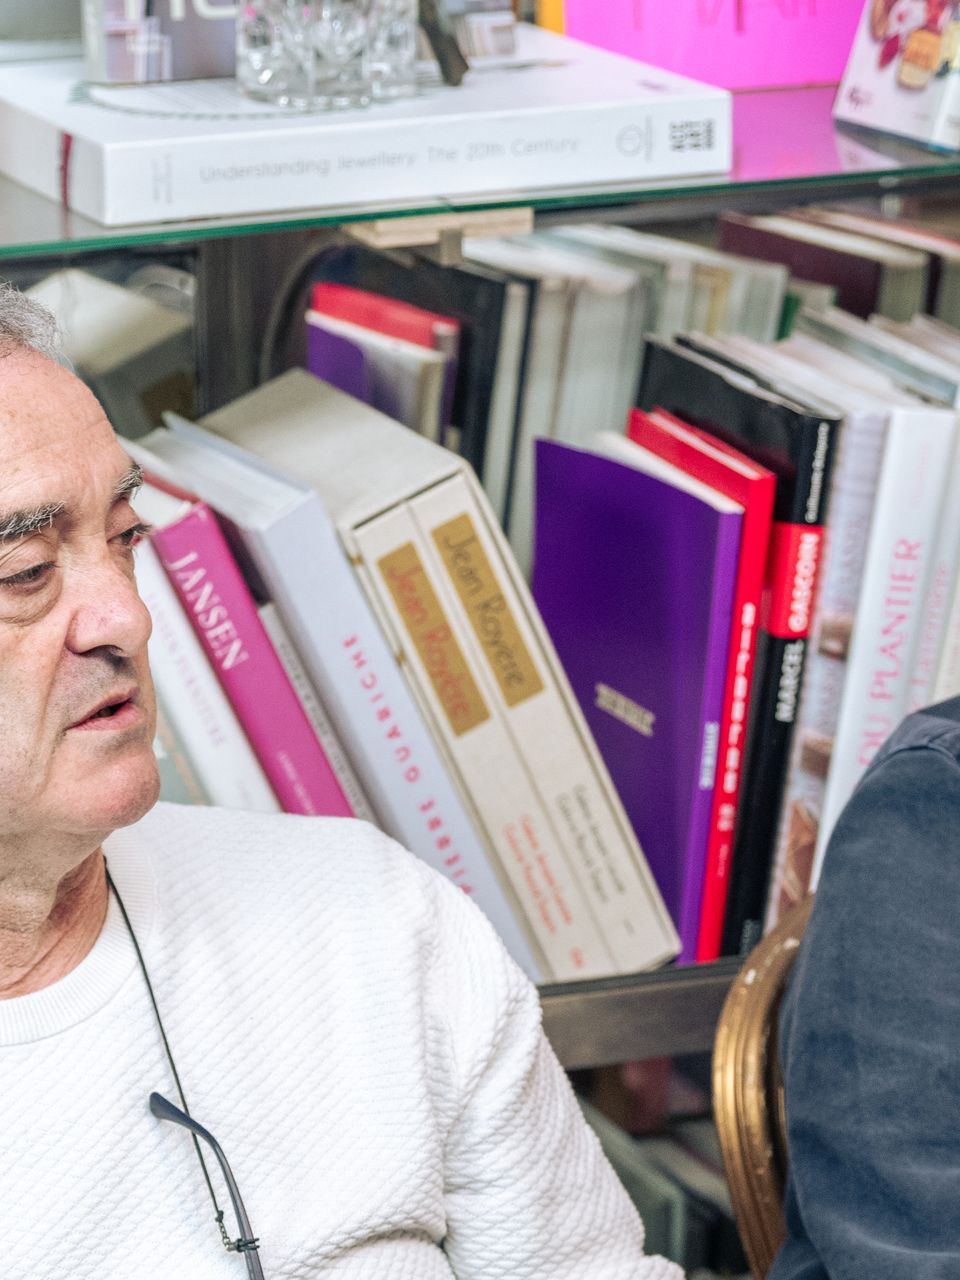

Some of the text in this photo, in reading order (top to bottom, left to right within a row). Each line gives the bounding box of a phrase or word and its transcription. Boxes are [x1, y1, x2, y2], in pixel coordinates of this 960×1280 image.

[198, 152, 330, 184] Understanding
[427, 144, 458, 163] The
[465, 140, 507, 161] 20th
[511, 135, 580, 159] Century
[166, 551, 250, 671] JANSEN
[444, 534, 483, 596] Jean
[775, 531, 820, 723] MARCEL GASCOIN
[870, 535, 925, 703] PLANTIER
[343, 634, 420, 783] GUARICHE
